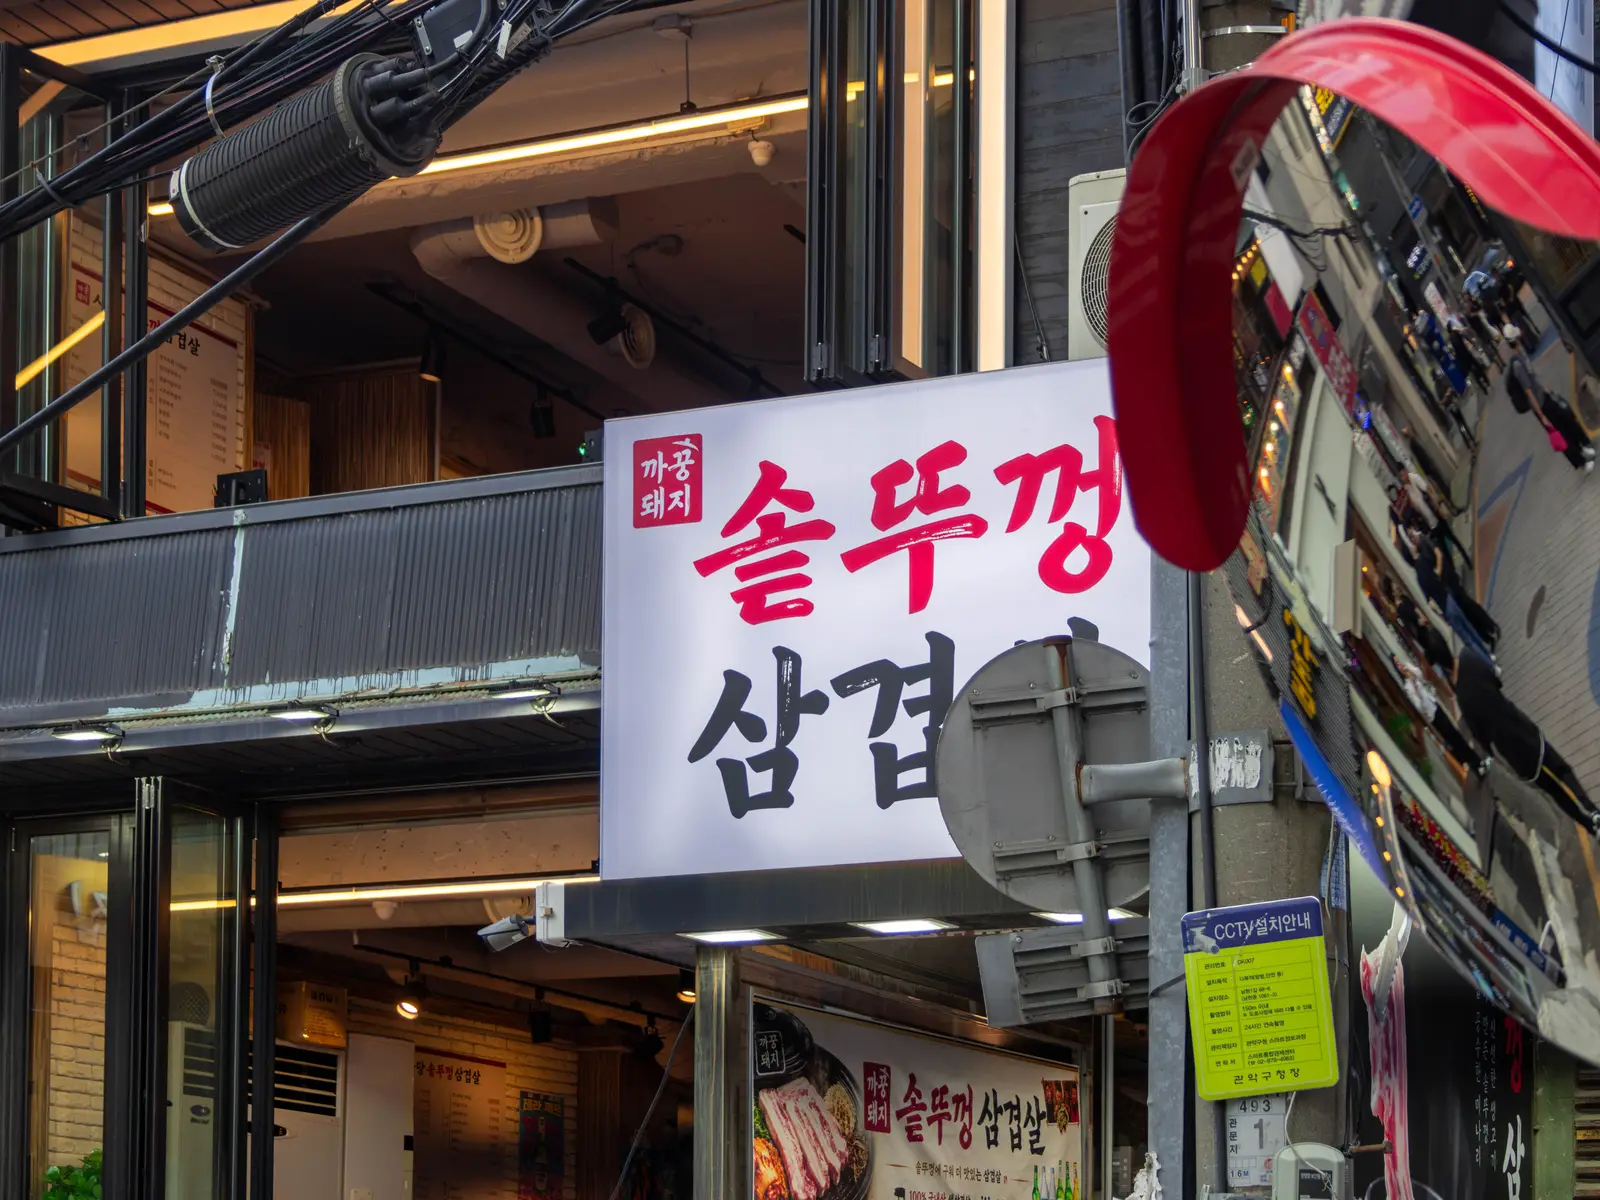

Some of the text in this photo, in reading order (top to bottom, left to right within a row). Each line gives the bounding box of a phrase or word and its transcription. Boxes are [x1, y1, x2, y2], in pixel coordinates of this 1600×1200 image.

[641, 438, 699, 484] 까꿍
[640, 483, 691, 519] 돼지
[693, 414, 1123, 626] 솥뚜껑
[1214, 911, 1311, 940] CCTV설치안내
[1246, 1038, 1268, 1047] 관악구청
[454, 1067, 482, 1085] 삼겹살
[867, 1099, 888, 1128] 돼지
[895, 1072, 1046, 1156] 솥뚜껑 삼겹살
[955, 1166, 962, 1180] 더
[983, 1169, 1002, 1184] 삼겹살
